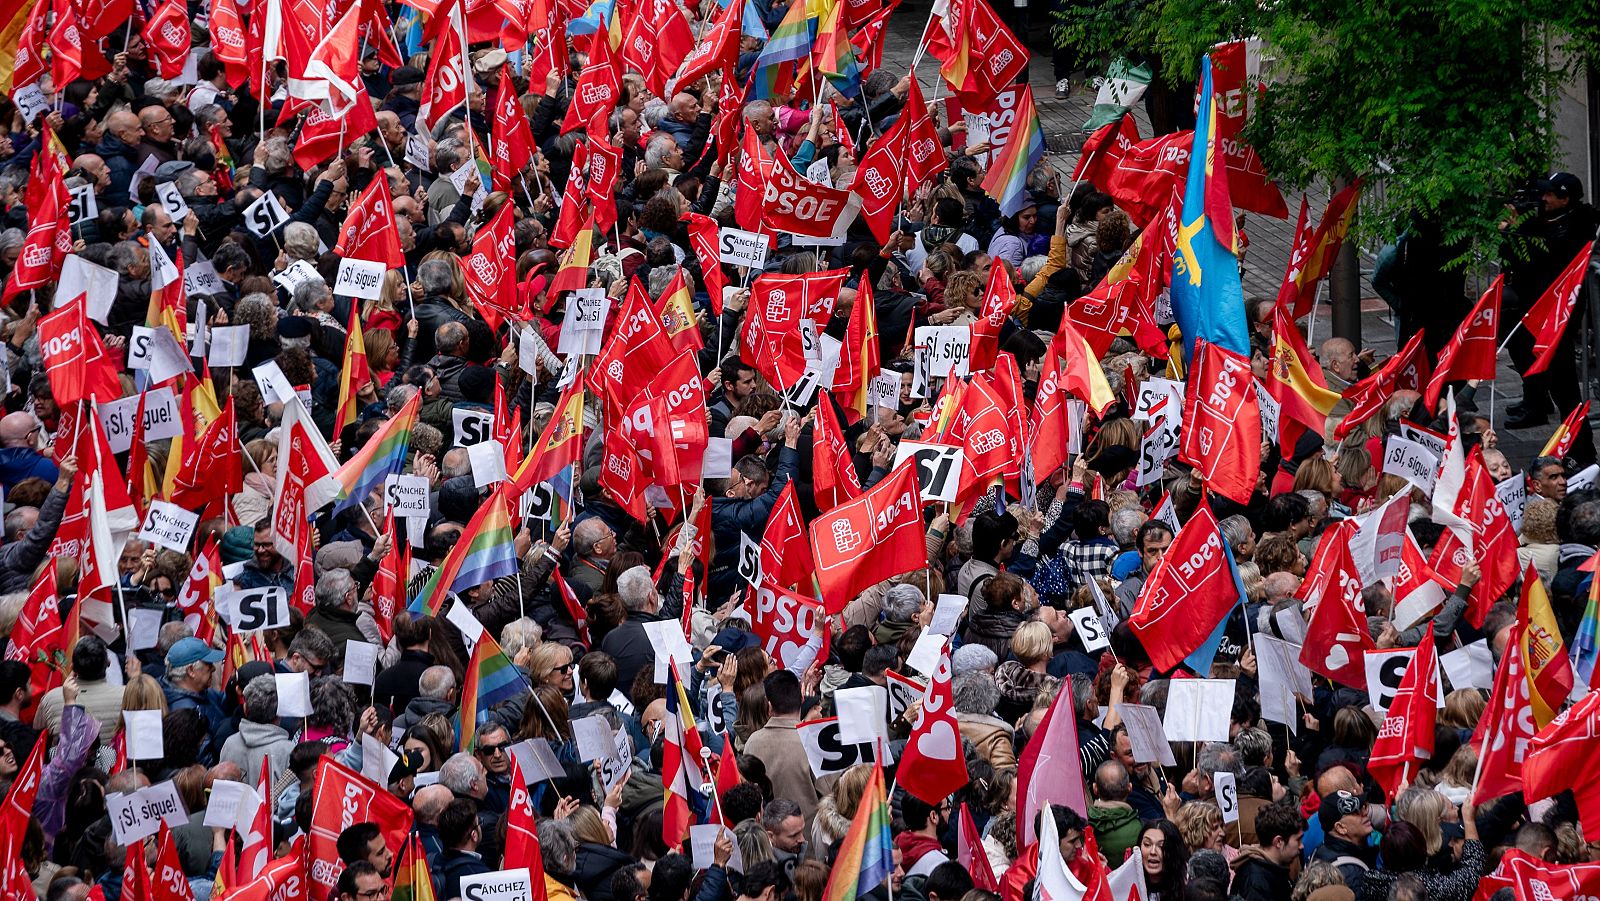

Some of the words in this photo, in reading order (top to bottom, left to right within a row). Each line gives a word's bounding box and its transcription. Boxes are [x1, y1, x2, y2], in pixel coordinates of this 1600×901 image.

[432, 54, 464, 105] SOE
[1220, 138, 1246, 158] SOE
[762, 179, 838, 222] PSOE
[354, 270, 380, 290] sigue!
[105, 406, 129, 441] ¡SÍ,
[459, 416, 490, 446] SÍ
[1387, 446, 1408, 468] ¡SÍ,
[1407, 455, 1432, 481] sigue!
[236, 587, 278, 631] SÍ
[757, 586, 817, 639] PSO
[118, 800, 141, 834] ¡SÍ,
[141, 794, 178, 820] sigue!
[160, 865, 187, 897] PSO
